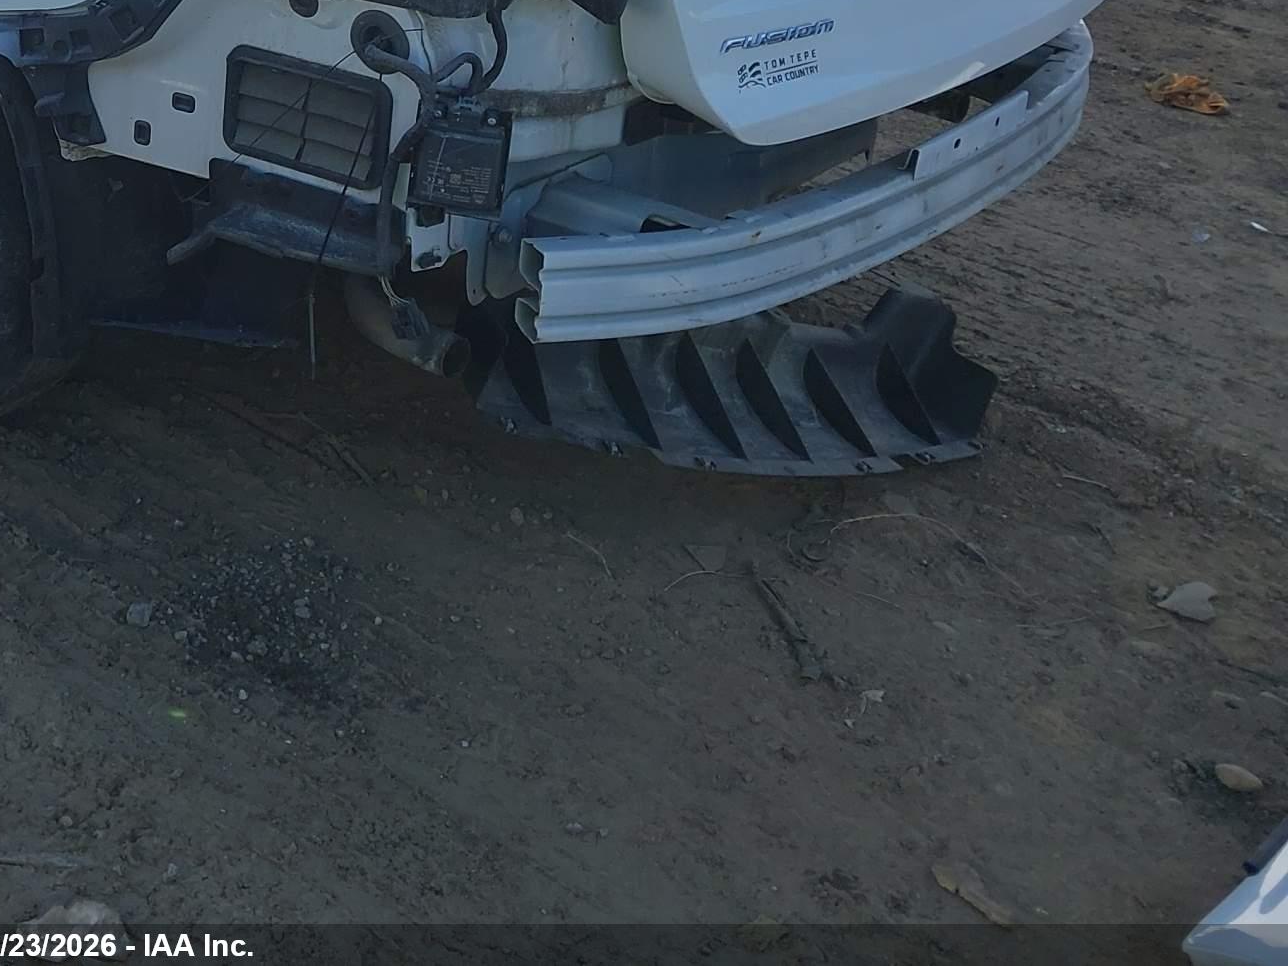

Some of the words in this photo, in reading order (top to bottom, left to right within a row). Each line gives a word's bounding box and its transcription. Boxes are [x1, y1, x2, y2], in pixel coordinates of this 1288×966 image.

[764, 57, 785, 71] TOM
[790, 49, 817, 63] TEPE
[766, 74, 783, 86] CAR
[785, 64, 819, 82] COUNTRY
